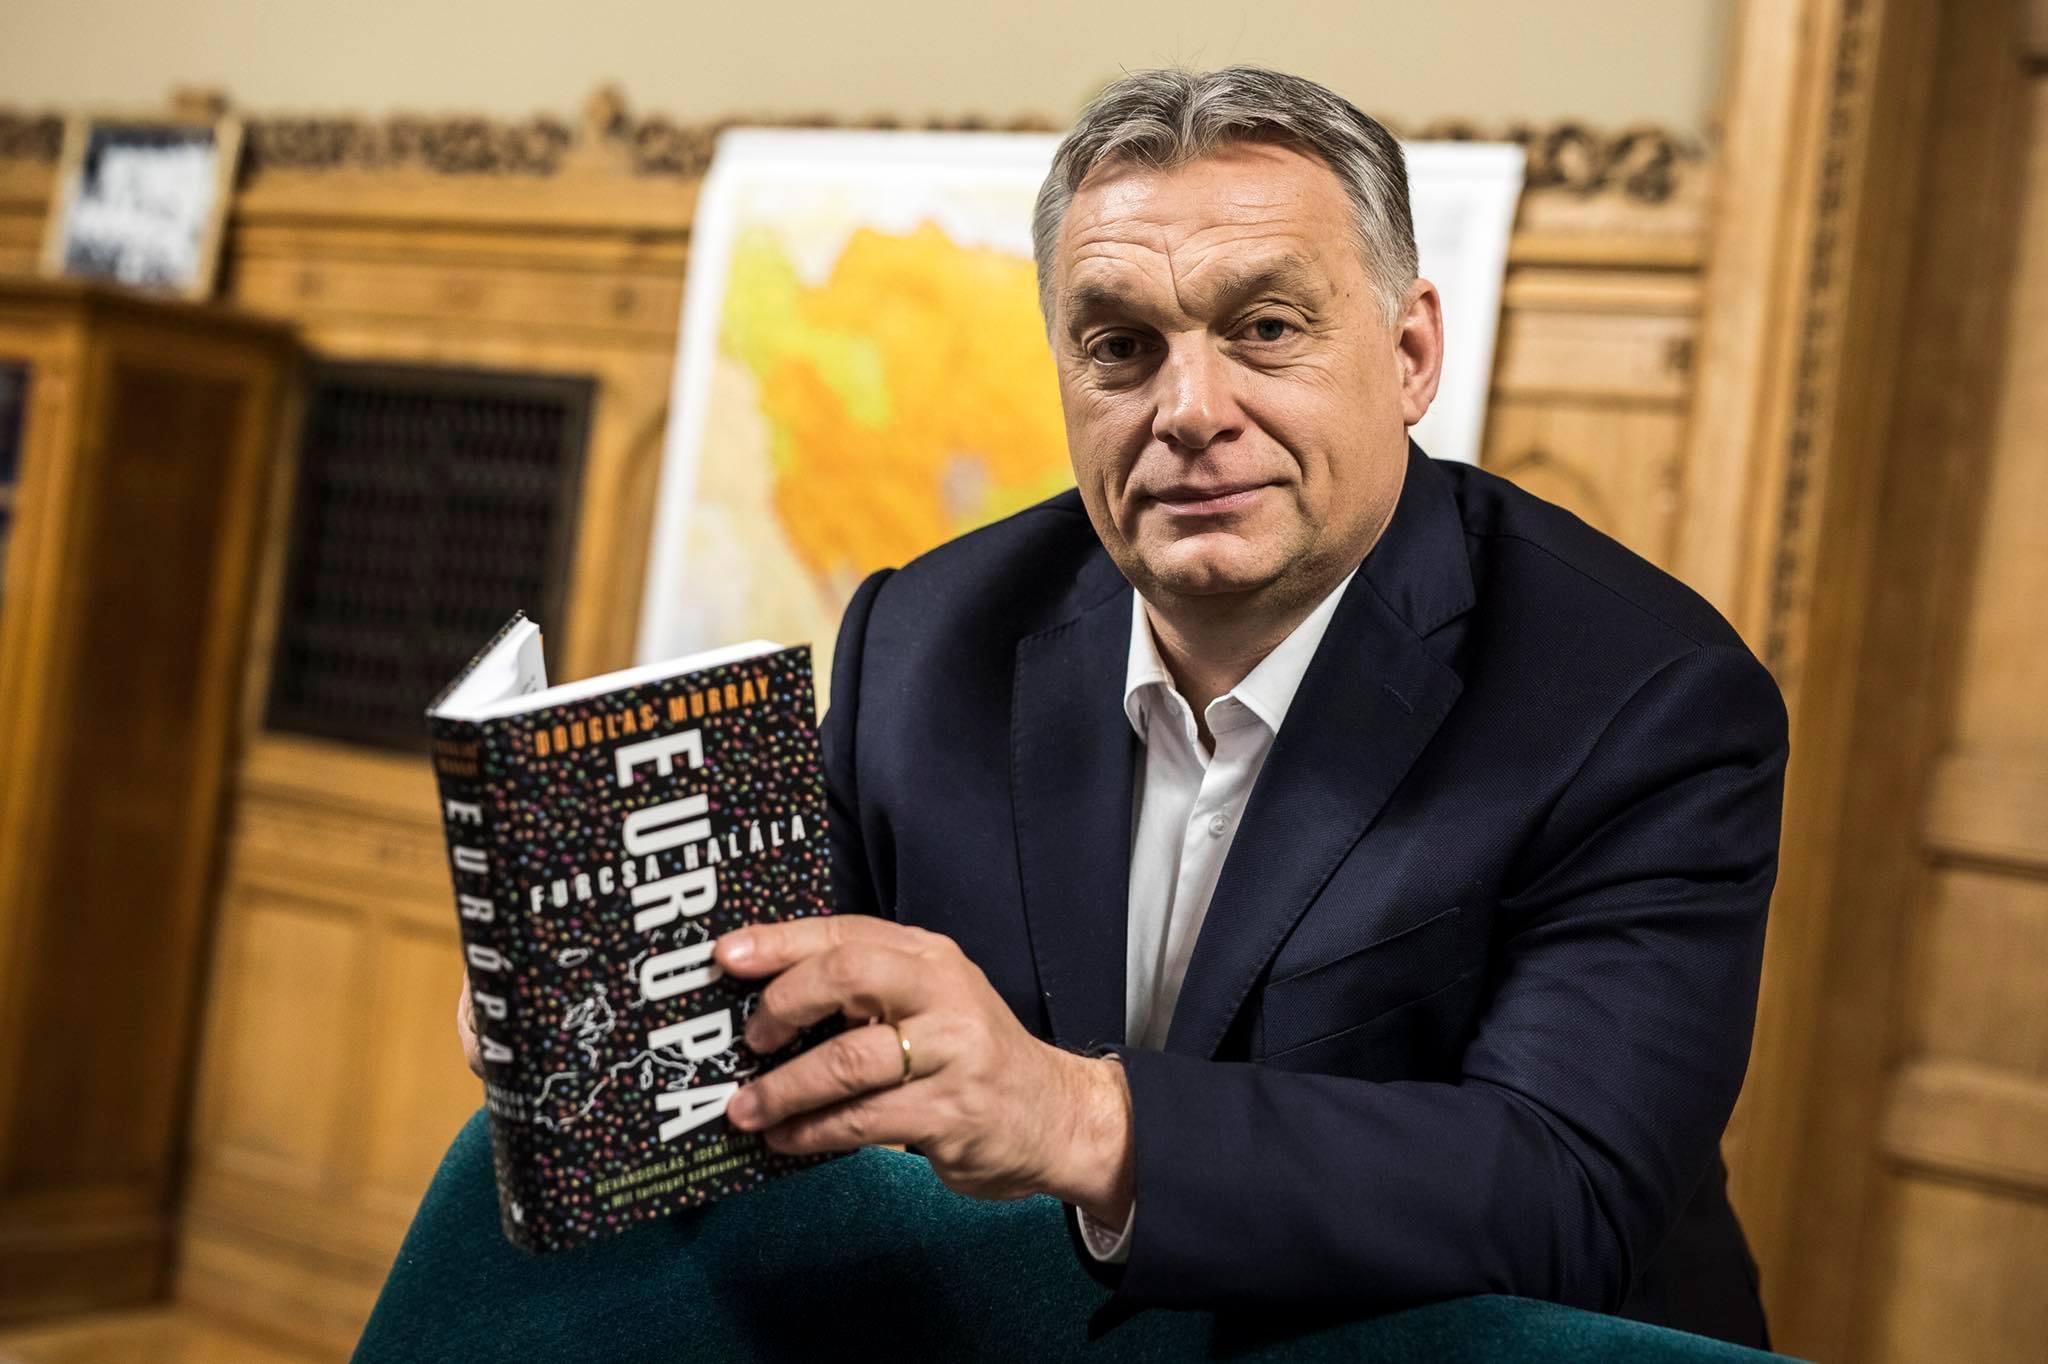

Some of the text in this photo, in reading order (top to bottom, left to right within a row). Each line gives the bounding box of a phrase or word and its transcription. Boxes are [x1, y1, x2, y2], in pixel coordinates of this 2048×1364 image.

[535, 675, 770, 757] DOUGLAS MURRAY
[530, 814, 806, 913] FURCSA HALÁLA
